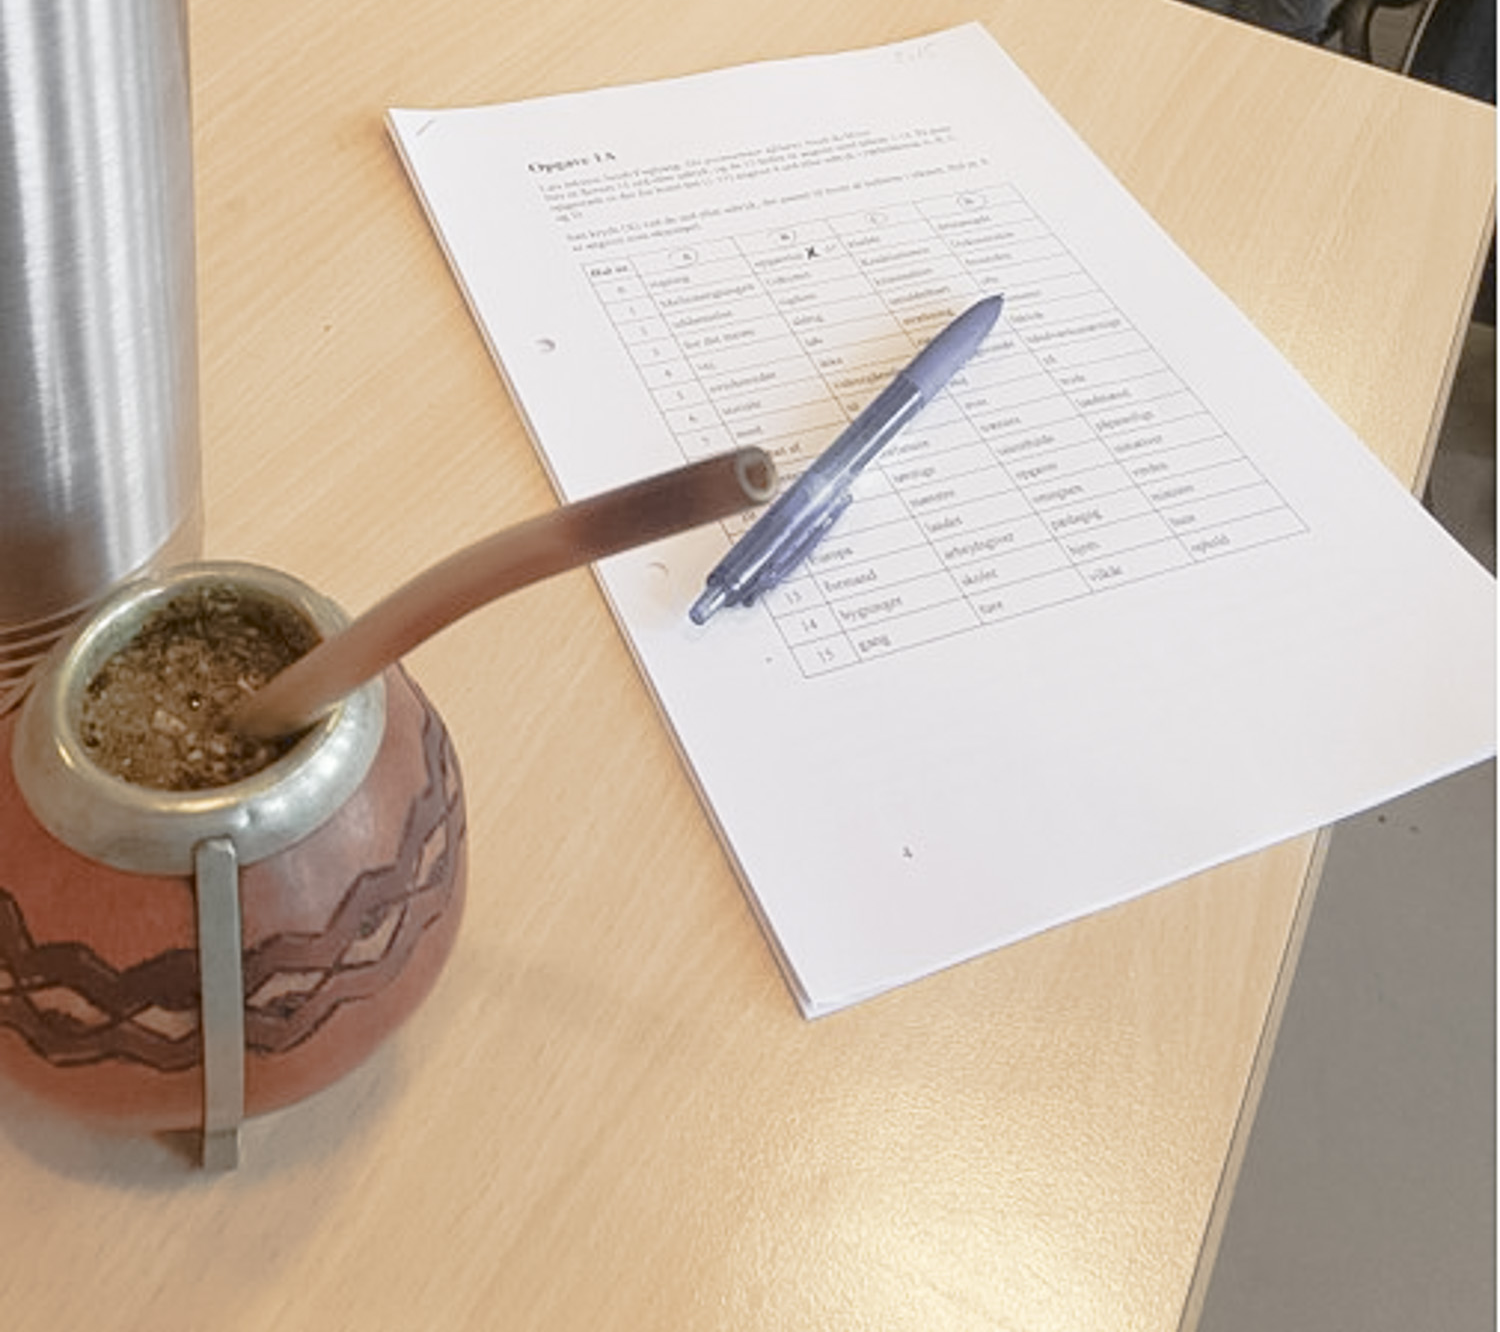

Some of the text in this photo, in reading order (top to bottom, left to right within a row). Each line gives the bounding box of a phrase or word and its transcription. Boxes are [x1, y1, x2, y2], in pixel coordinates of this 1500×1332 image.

[528, 156, 588, 173] Opgave
[859, 634, 891, 653] gang
[816, 648, 835, 663] 15
